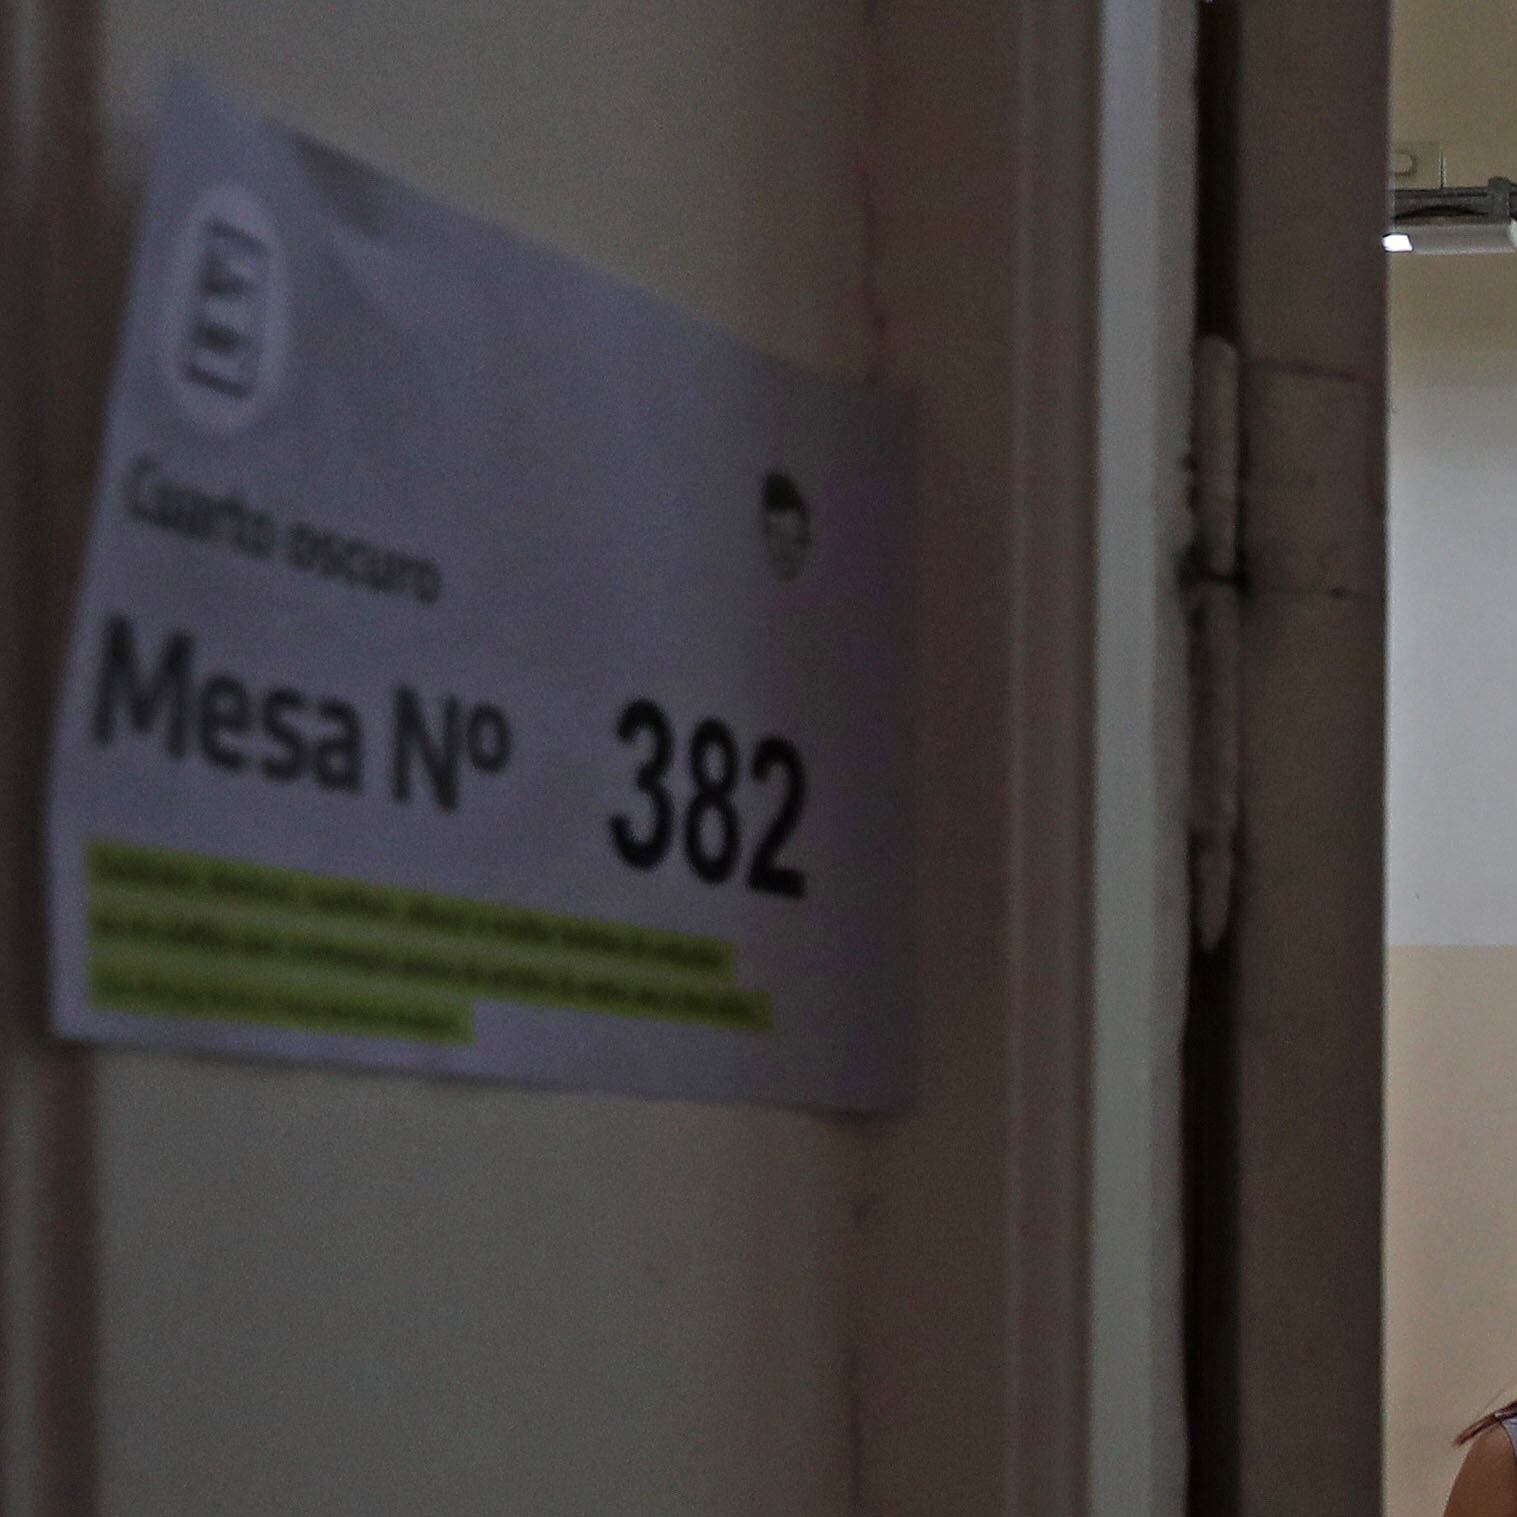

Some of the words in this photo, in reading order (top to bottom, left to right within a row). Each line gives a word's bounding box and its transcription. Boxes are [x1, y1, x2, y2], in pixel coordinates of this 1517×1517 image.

[122, 454, 275, 558] Cuarto
[285, 520, 443, 606] oscuro
[92, 612, 366, 796] Mesa
[608, 696, 810, 902] 382
